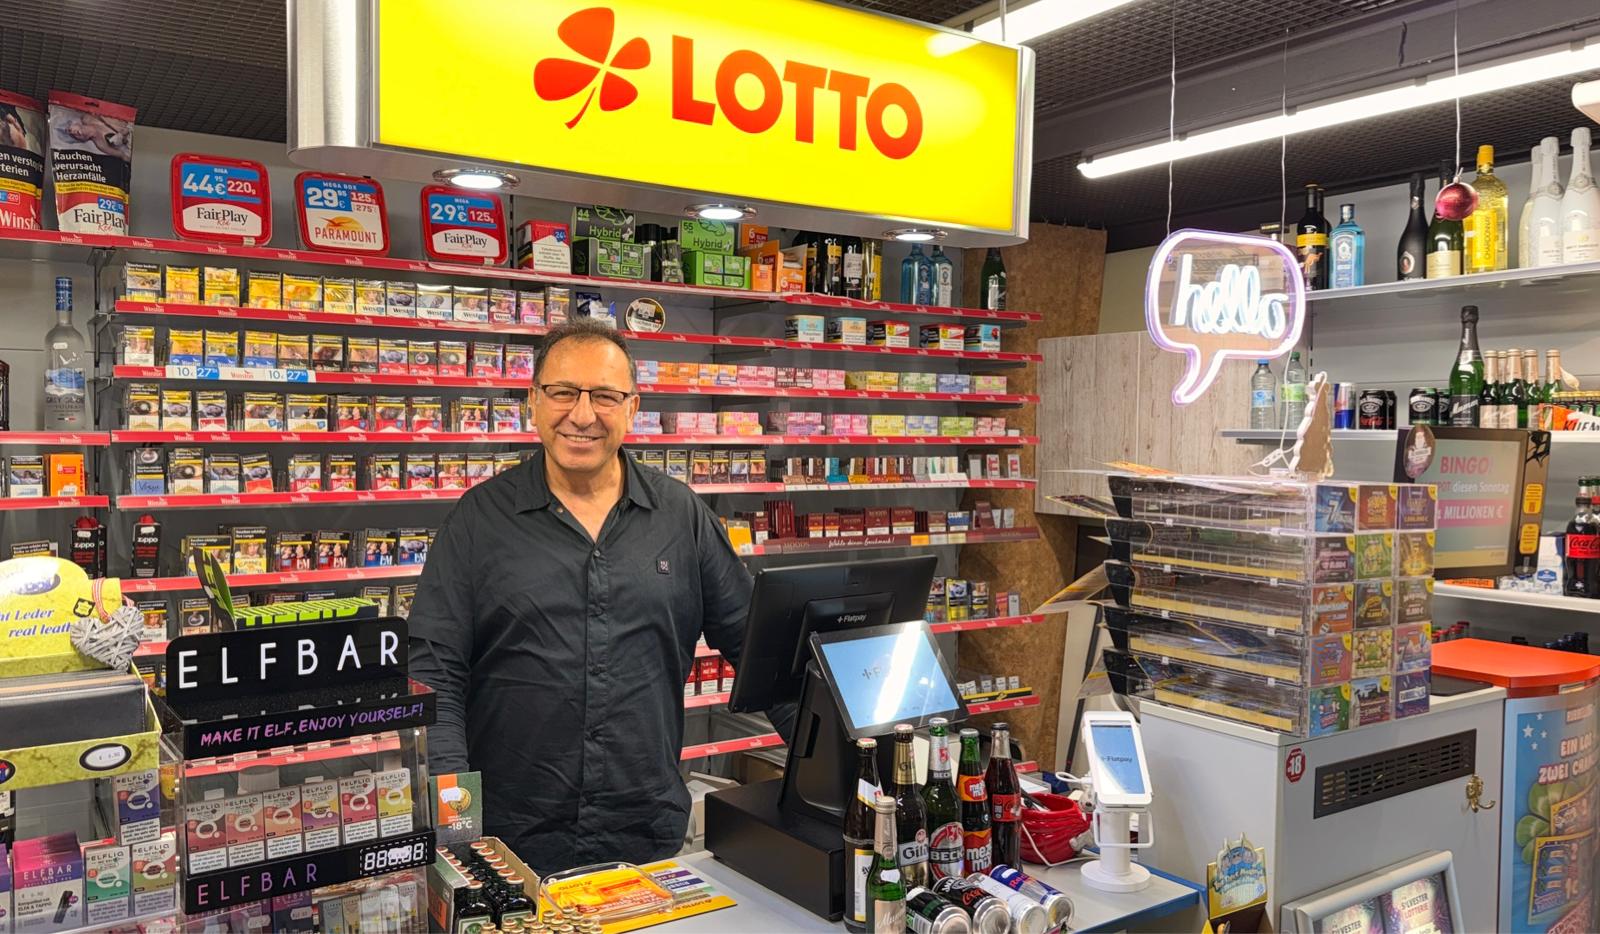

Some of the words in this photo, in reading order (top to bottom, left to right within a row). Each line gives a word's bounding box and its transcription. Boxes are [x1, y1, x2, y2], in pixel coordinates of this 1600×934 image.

[672, 34, 924, 161] LOTTO
[54, 151, 92, 162] Rauchen
[55, 161, 102, 173] verursacht
[56, 172, 106, 183] Herzanfälle
[184, 173, 213, 194] 44
[306, 187, 338, 208] 29
[431, 203, 456, 220] 29
[314, 226, 377, 244] PARAMOUNT
[589, 225, 622, 239] Hybrid
[693, 238, 723, 250] Hybrid
[1169, 253, 1289, 339] hello
[177, 367, 190, 377] 10
[1443, 505, 1495, 519] MILLIONEN
[75, 540, 96, 549] zippo
[137, 536, 159, 545] zippo
[14, 608, 55, 620] Leder
[8, 624, 37, 637] real
[178, 630, 400, 689] ELFBAR
[200, 728, 243, 746] MAKE
[247, 725, 261, 740] IT
[349, 702, 424, 727] YOURSELF!
[1538, 763, 1569, 784] ZWEI
[23, 864, 72, 881] ELFBAR
[197, 863, 317, 905] ELFBAR
[1401, 893, 1429, 910] SILVESTER
